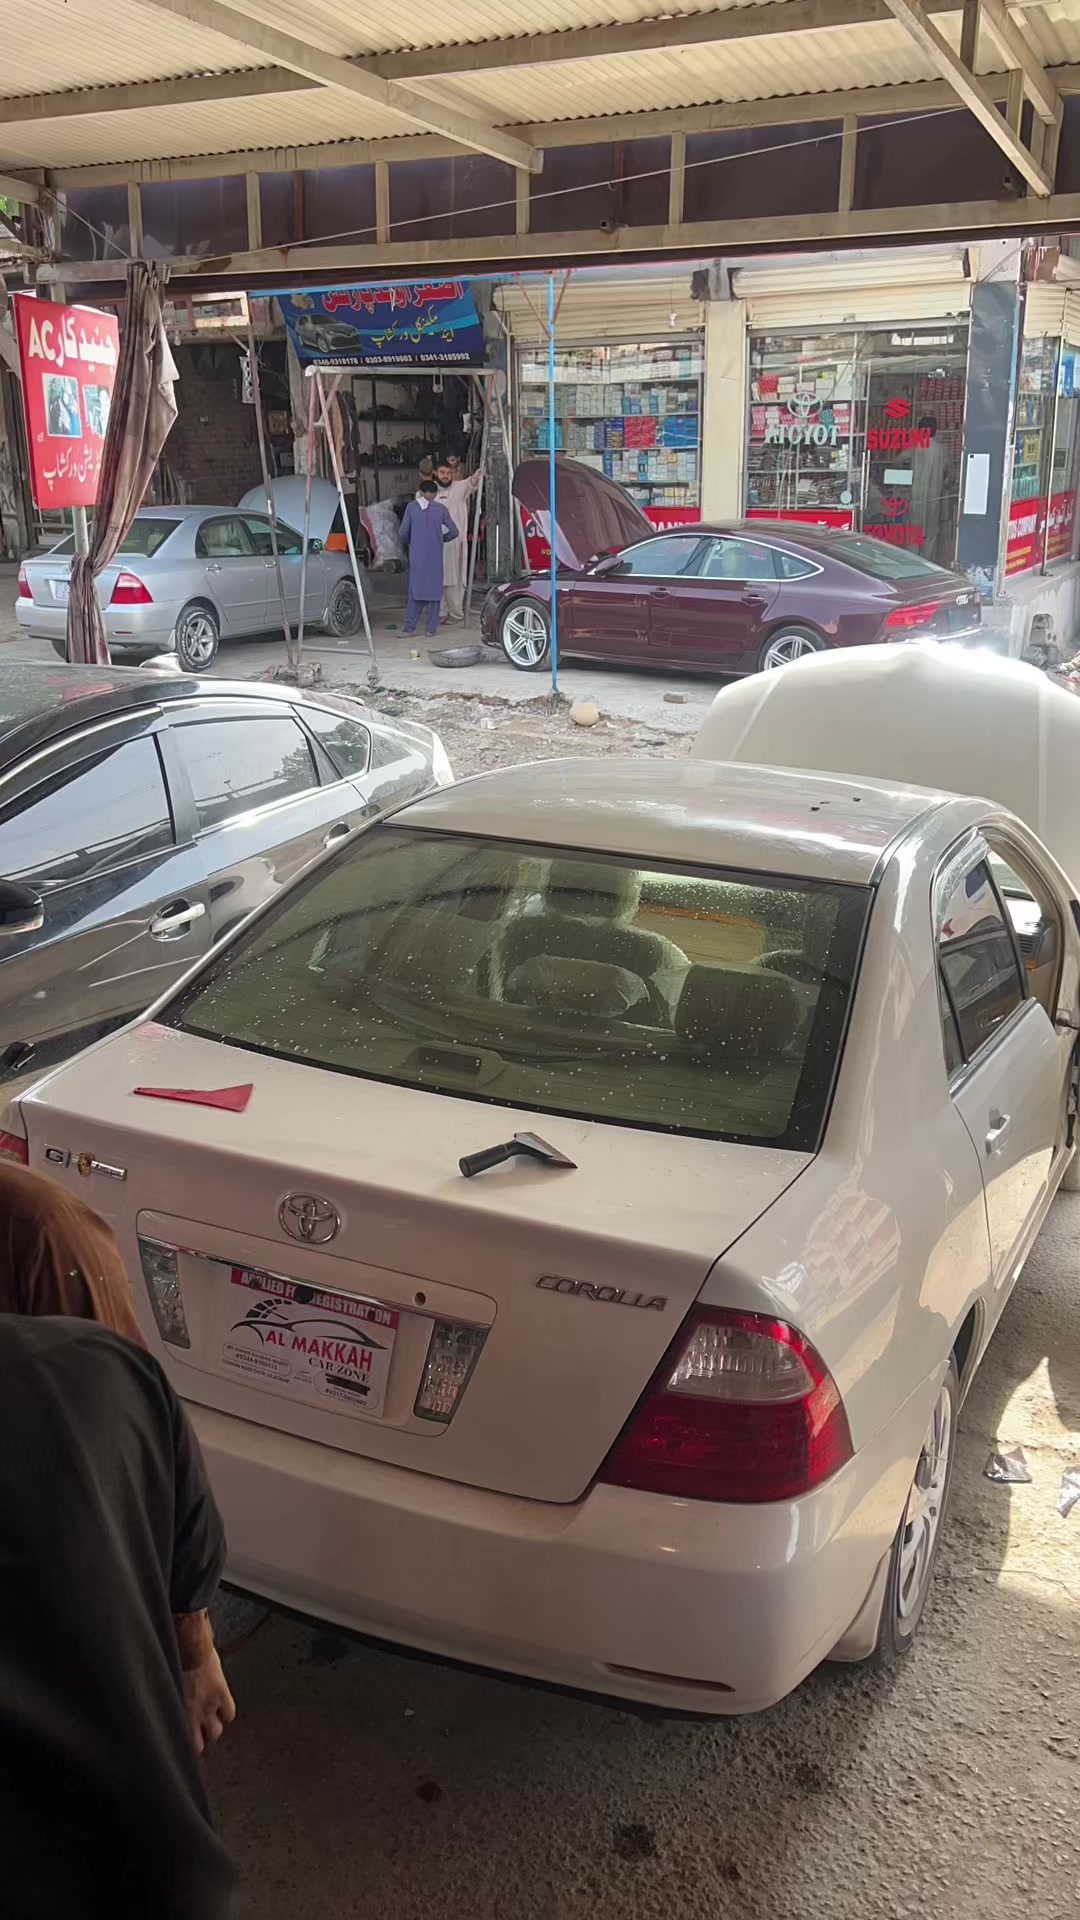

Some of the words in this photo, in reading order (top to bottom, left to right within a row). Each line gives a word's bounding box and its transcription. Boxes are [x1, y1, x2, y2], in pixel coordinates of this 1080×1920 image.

[28, 316, 56, 361] AC
[866, 427, 932, 451] SUZUKI
[863, 524, 924, 546] TOYOTA
[535, 1274, 668, 1312] COROLLA
[265, 1330, 285, 1347] AL
[291, 1336, 373, 1373] MAKKAH
[308, 1357, 334, 1372] CAR
[337, 1365, 369, 1383] ZONE
